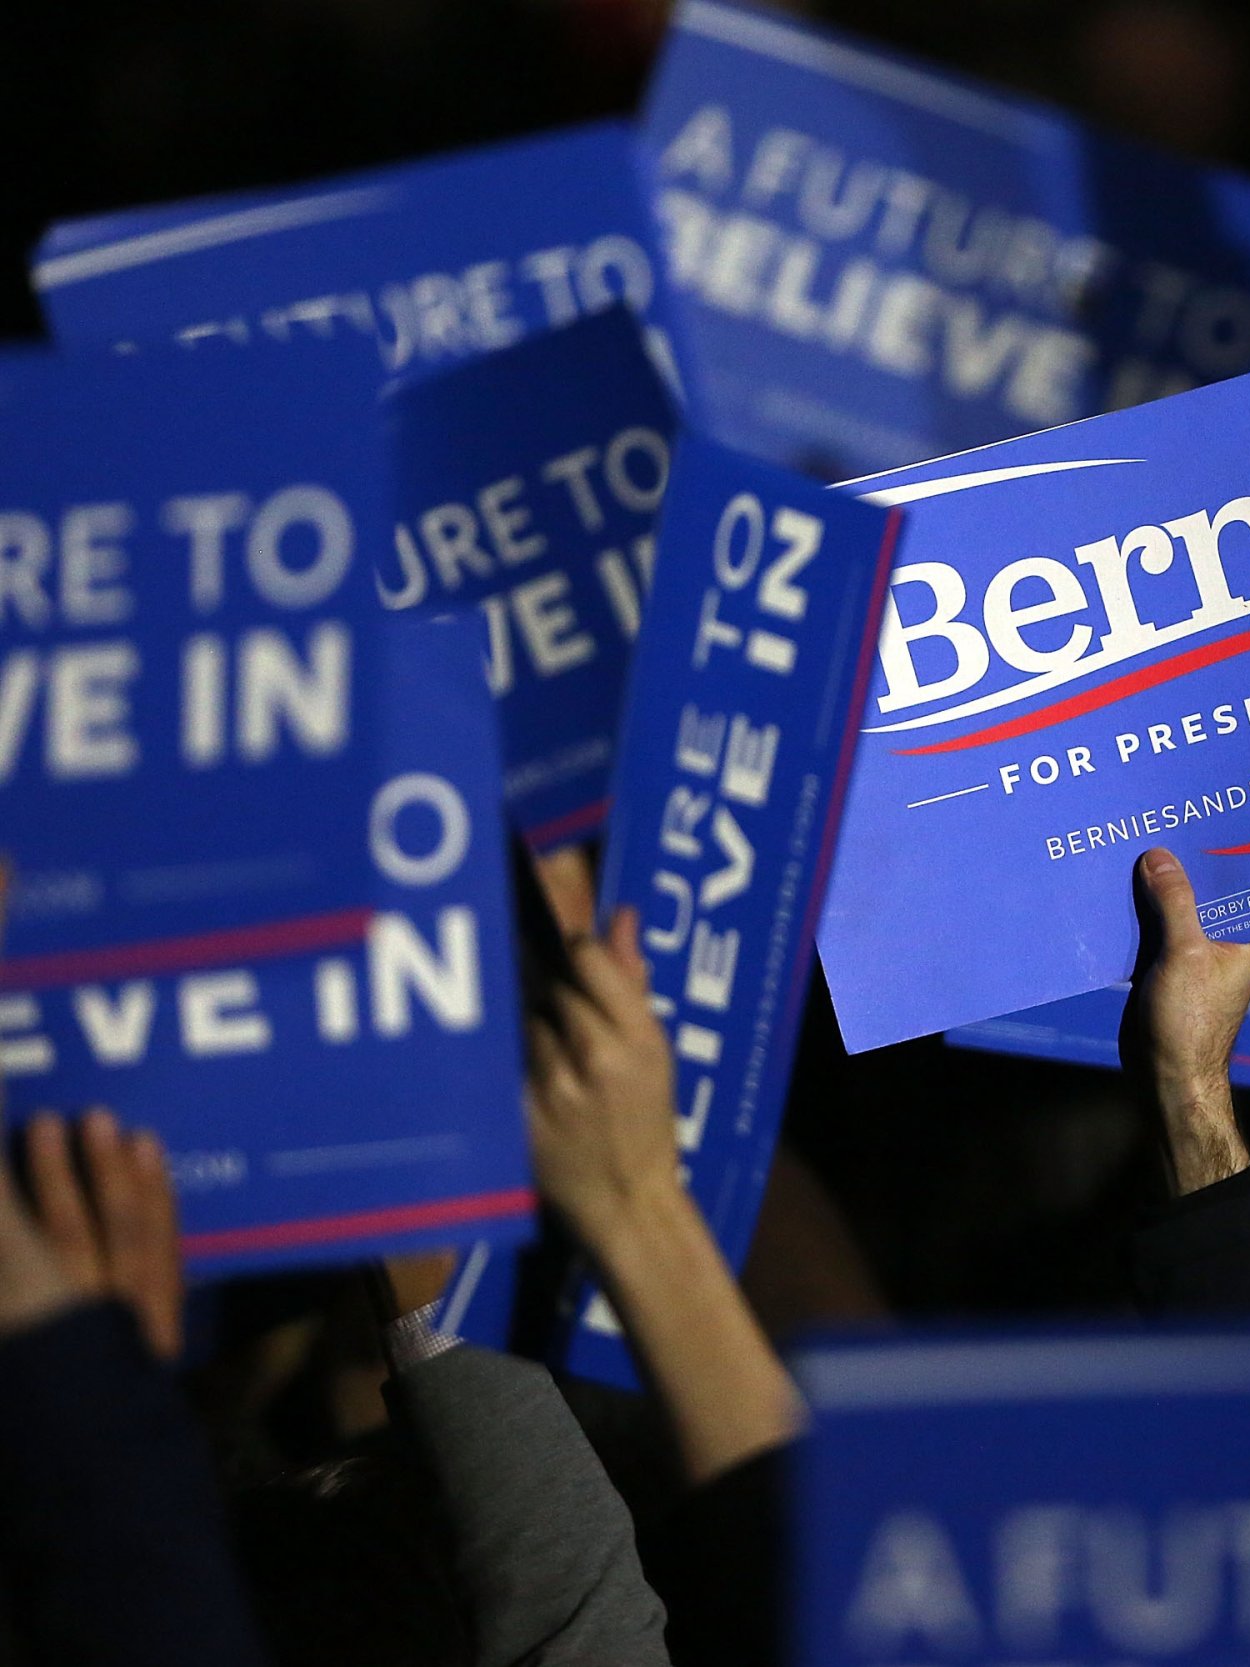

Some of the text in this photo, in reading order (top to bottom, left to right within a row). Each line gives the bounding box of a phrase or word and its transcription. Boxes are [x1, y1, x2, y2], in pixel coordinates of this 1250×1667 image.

[538, 425, 672, 536] TO
[160, 482, 356, 612] TO
[692, 490, 766, 672] TO
[746, 506, 826, 677] IN
[180, 618, 352, 768] IN
[999, 746, 1096, 795] FOR
[312, 905, 484, 1044] IN
[1198, 904, 1228, 924] FOR
[1228, 897, 1245, 914] BY
[1226, 922, 1243, 933] THE
